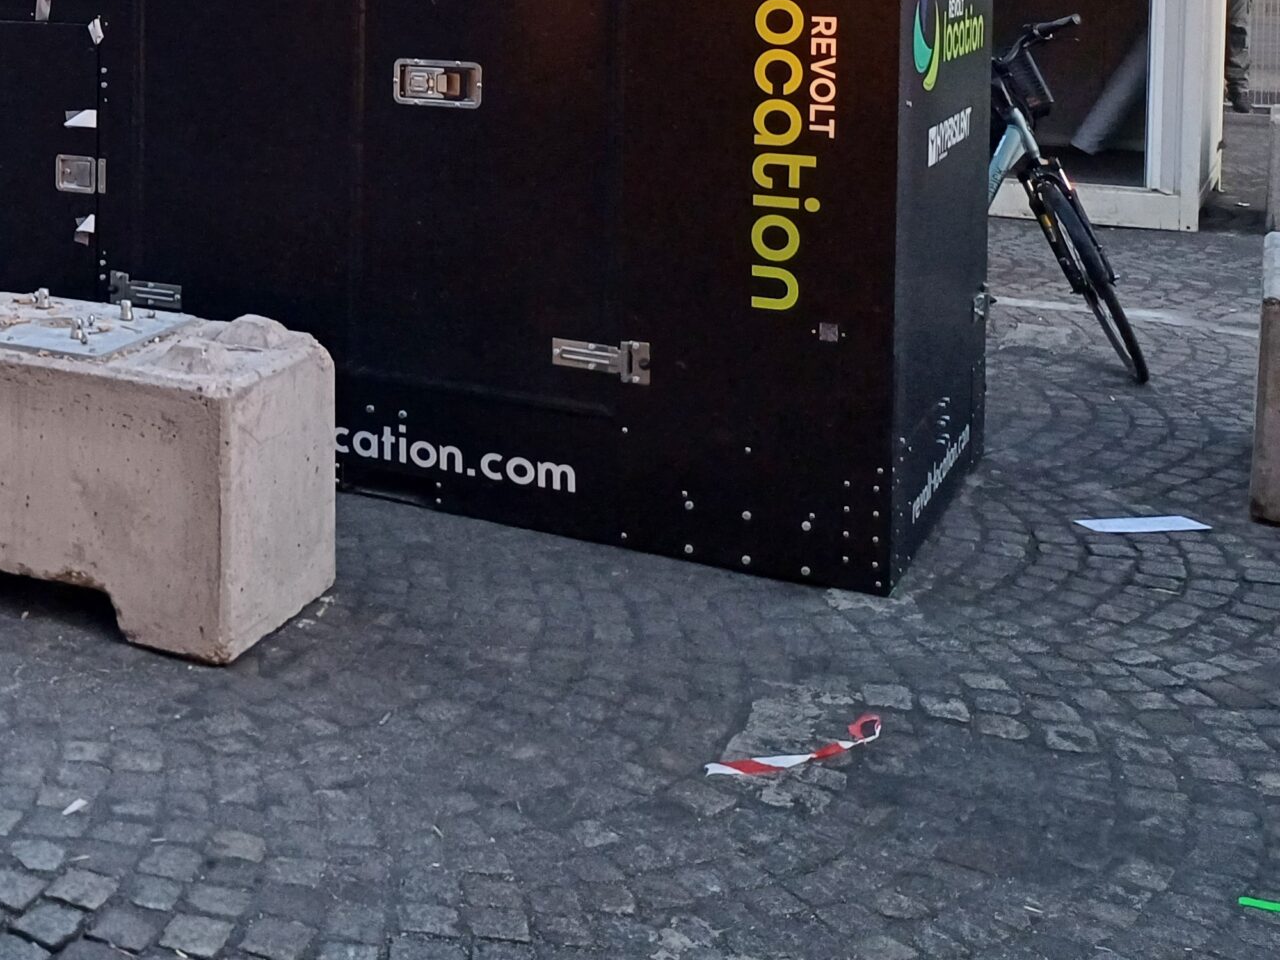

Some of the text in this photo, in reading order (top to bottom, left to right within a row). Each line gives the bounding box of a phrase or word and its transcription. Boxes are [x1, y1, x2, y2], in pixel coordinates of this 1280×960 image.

[943, 4, 985, 62] location
[809, 16, 838, 139] REVOLT
[335, 424, 576, 493] cation.com
